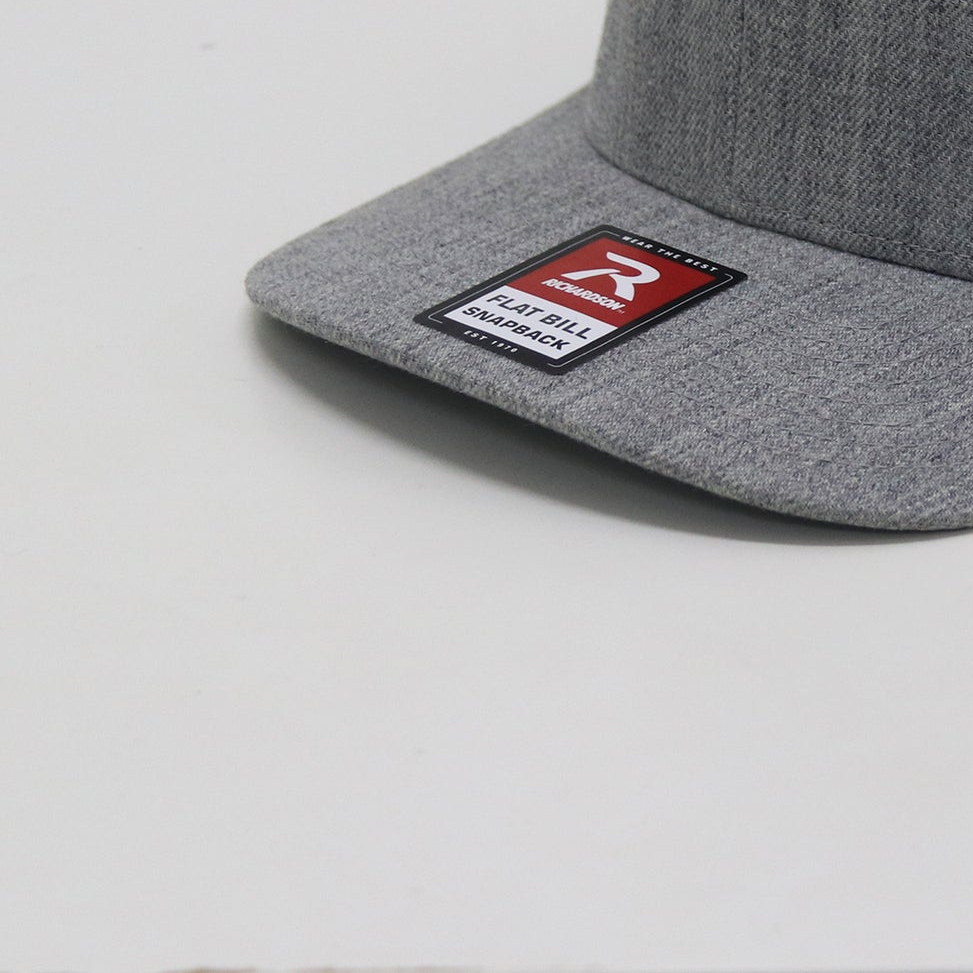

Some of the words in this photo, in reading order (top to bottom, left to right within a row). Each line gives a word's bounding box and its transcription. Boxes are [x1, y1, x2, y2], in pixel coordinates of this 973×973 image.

[622, 235, 653, 249] WEAR
[657, 248, 681, 259] THE
[684, 258, 718, 272] BEST
[541, 278, 626, 311] RICHARDSON
[462, 306, 570, 351] SNAPBACK
[486, 294, 544, 315] FLAT
[539, 313, 594, 340] BILL
